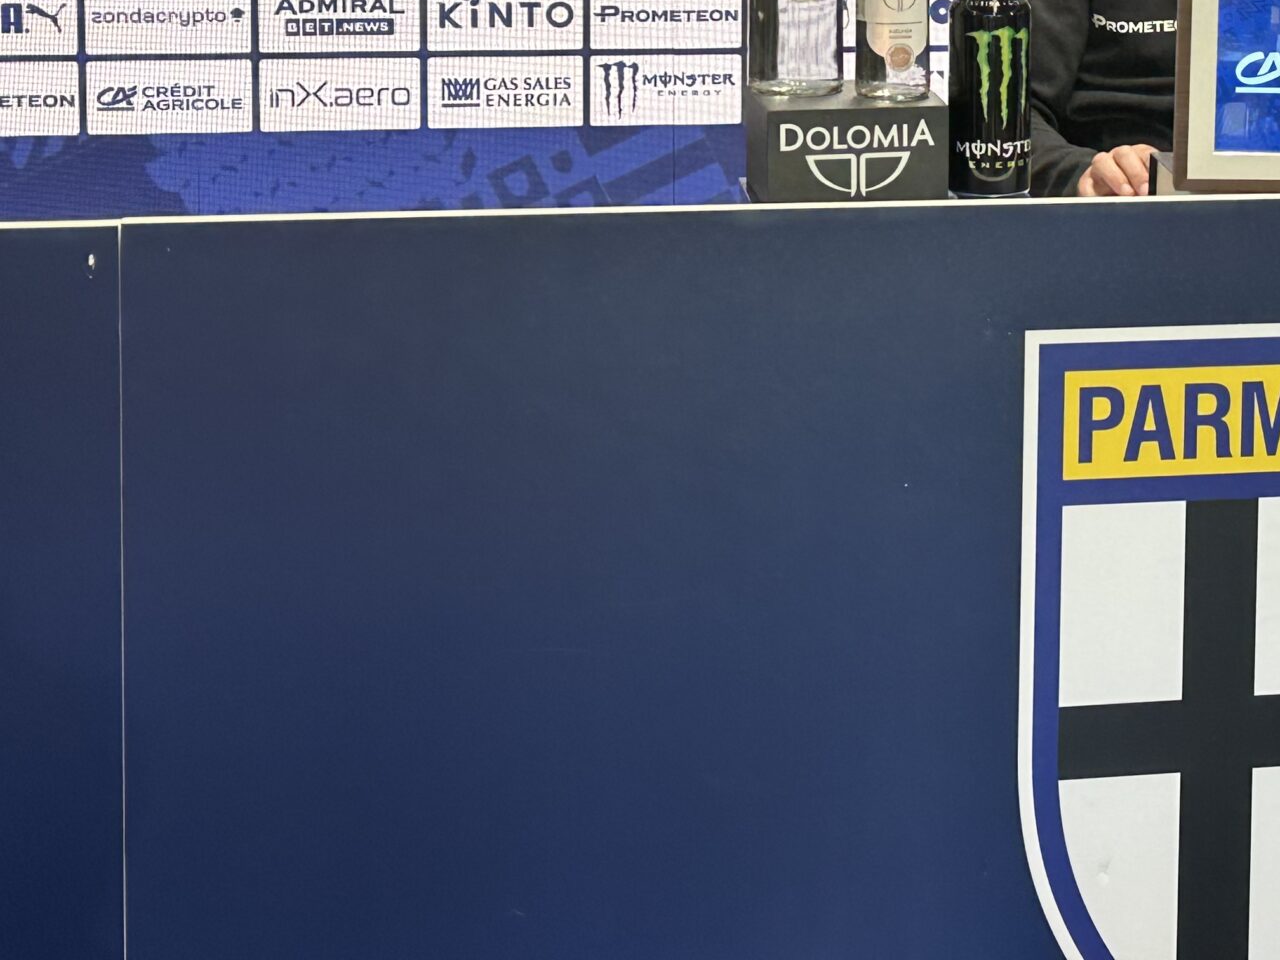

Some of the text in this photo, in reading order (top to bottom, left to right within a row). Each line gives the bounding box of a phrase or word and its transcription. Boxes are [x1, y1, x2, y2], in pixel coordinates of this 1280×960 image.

[91, 7, 226, 23] zondacrypto
[594, 6, 738, 23] PROMETEON
[484, 78, 571, 89] GAS SALES
[142, 85, 215, 97] CRÉDIT
[142, 98, 242, 111] AGRICOLE
[486, 94, 571, 106] ENERGIA
[779, 118, 935, 150] DOLOMIA
